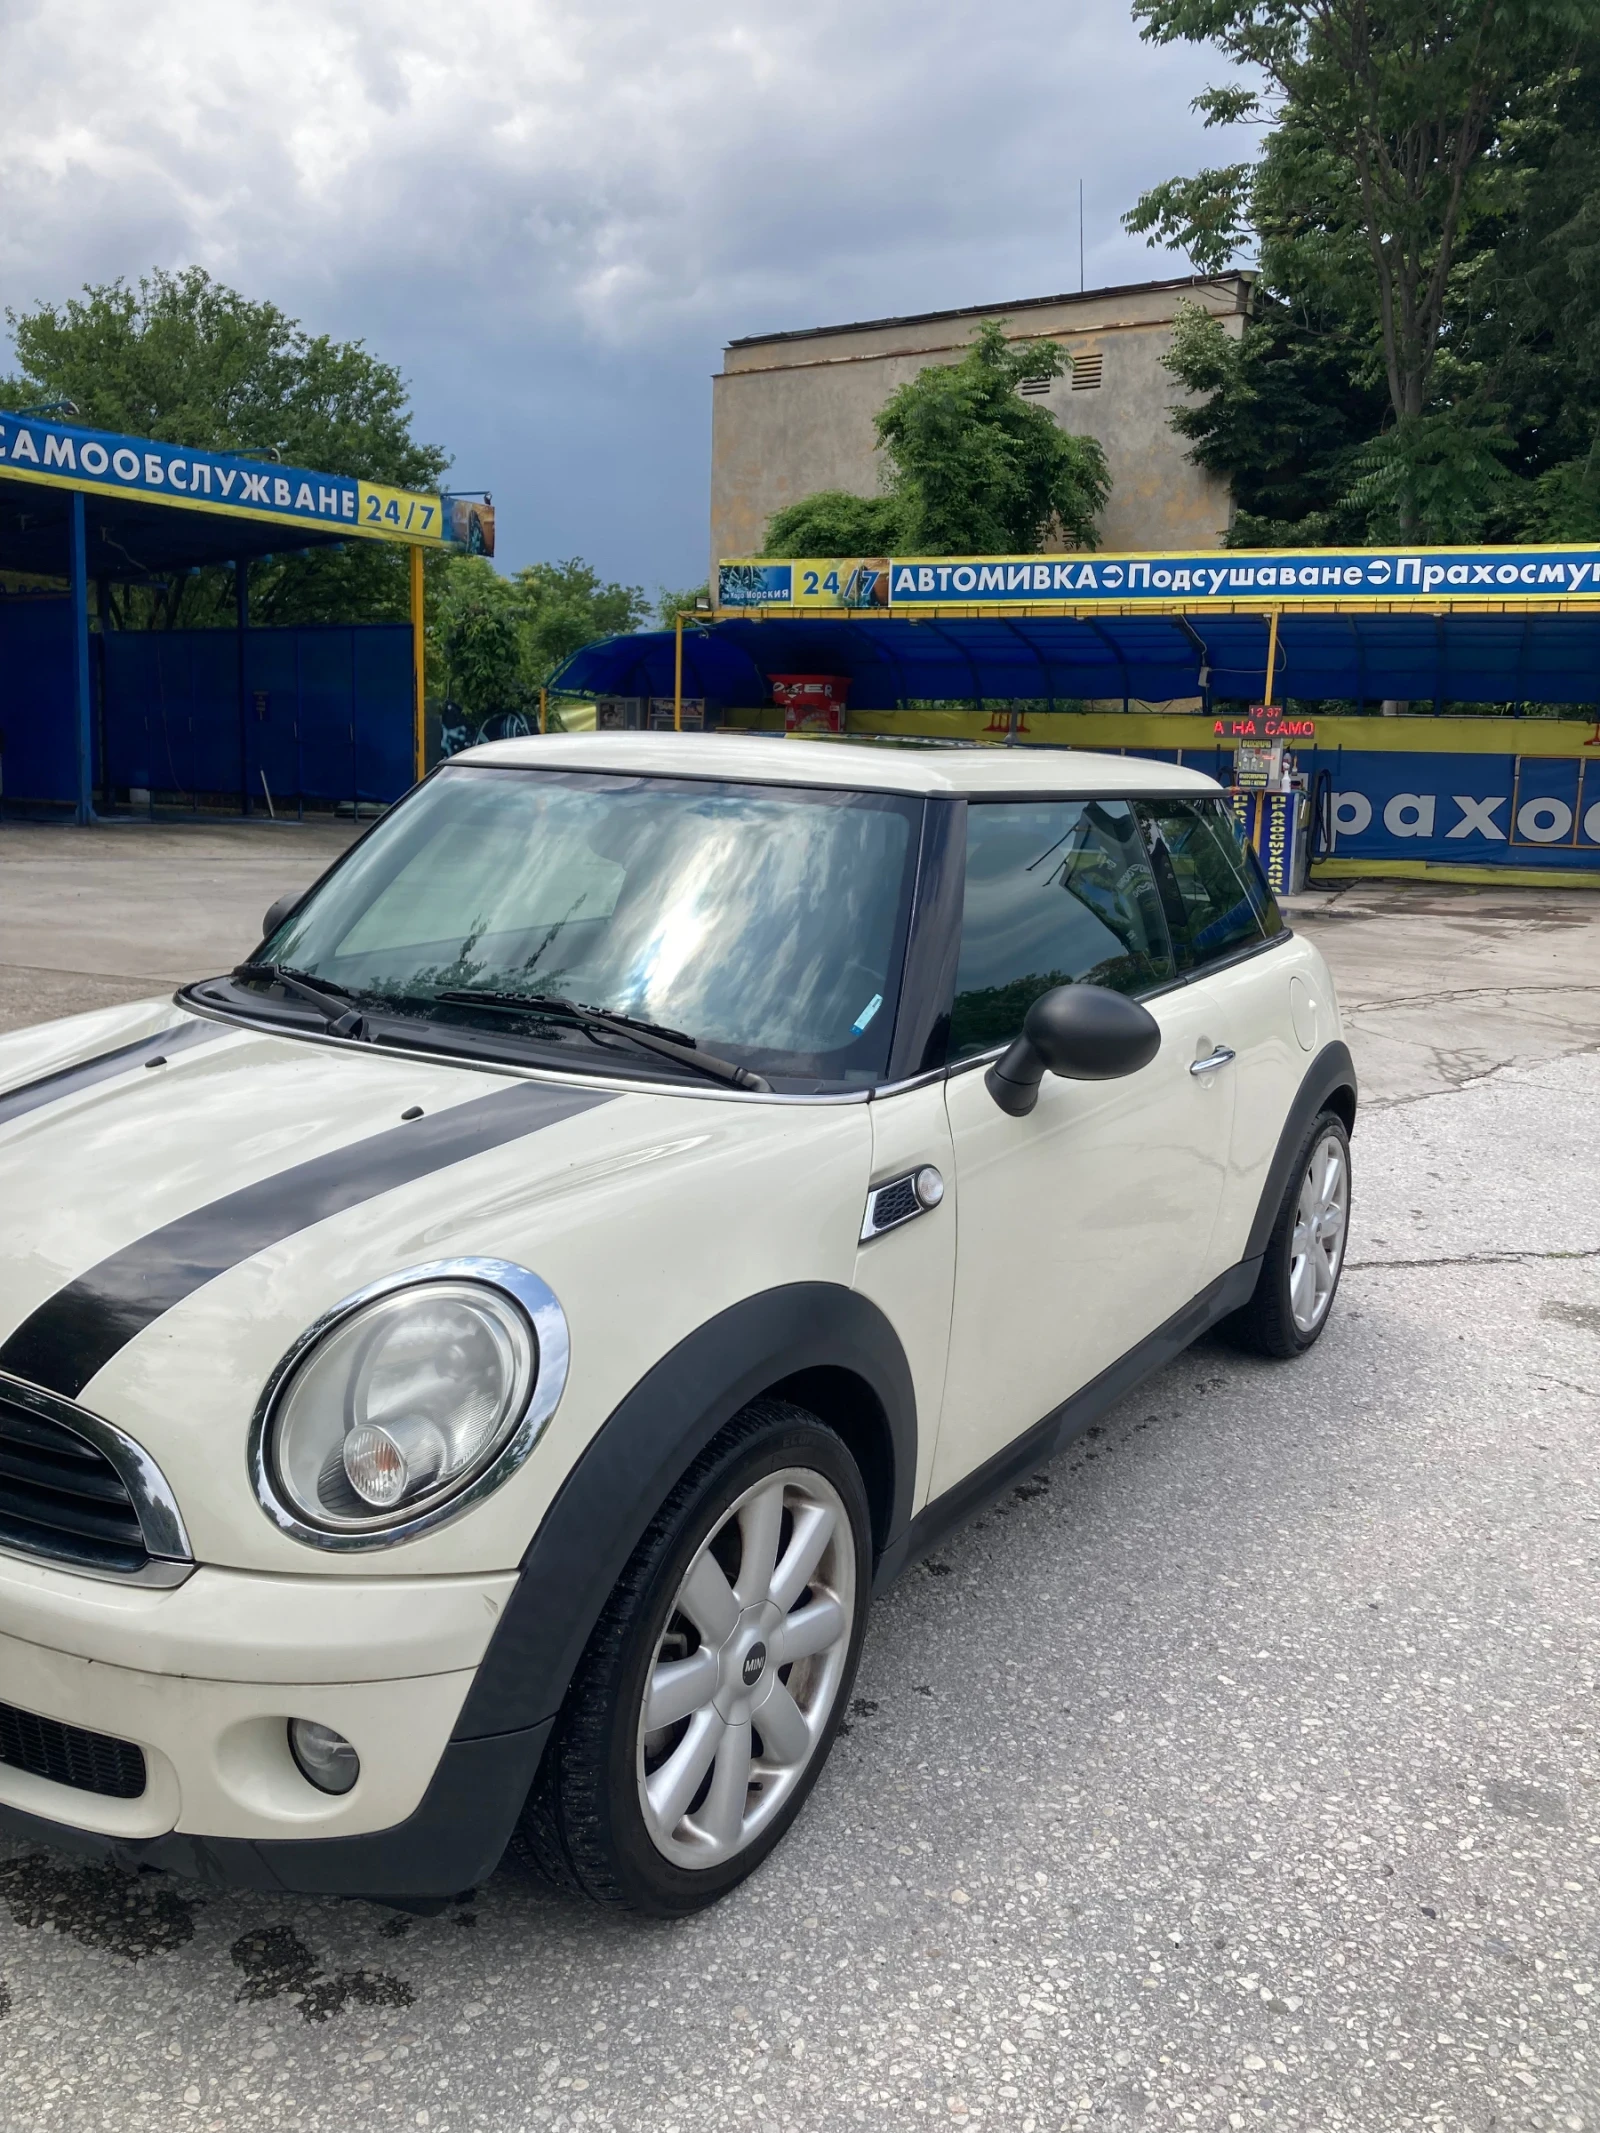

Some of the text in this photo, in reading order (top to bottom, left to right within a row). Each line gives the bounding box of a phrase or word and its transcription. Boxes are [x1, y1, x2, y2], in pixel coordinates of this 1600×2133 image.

[365, 495, 435, 530] 24/7
[803, 570, 880, 598] 24/7
[894, 564, 1098, 592] АВТОМИВКА
[1128, 562, 1364, 595] Подсушаване
[1213, 720, 1315, 735] А НА САМО
[1268, 795, 1287, 893] ПРАХОСМУКАЧКА
